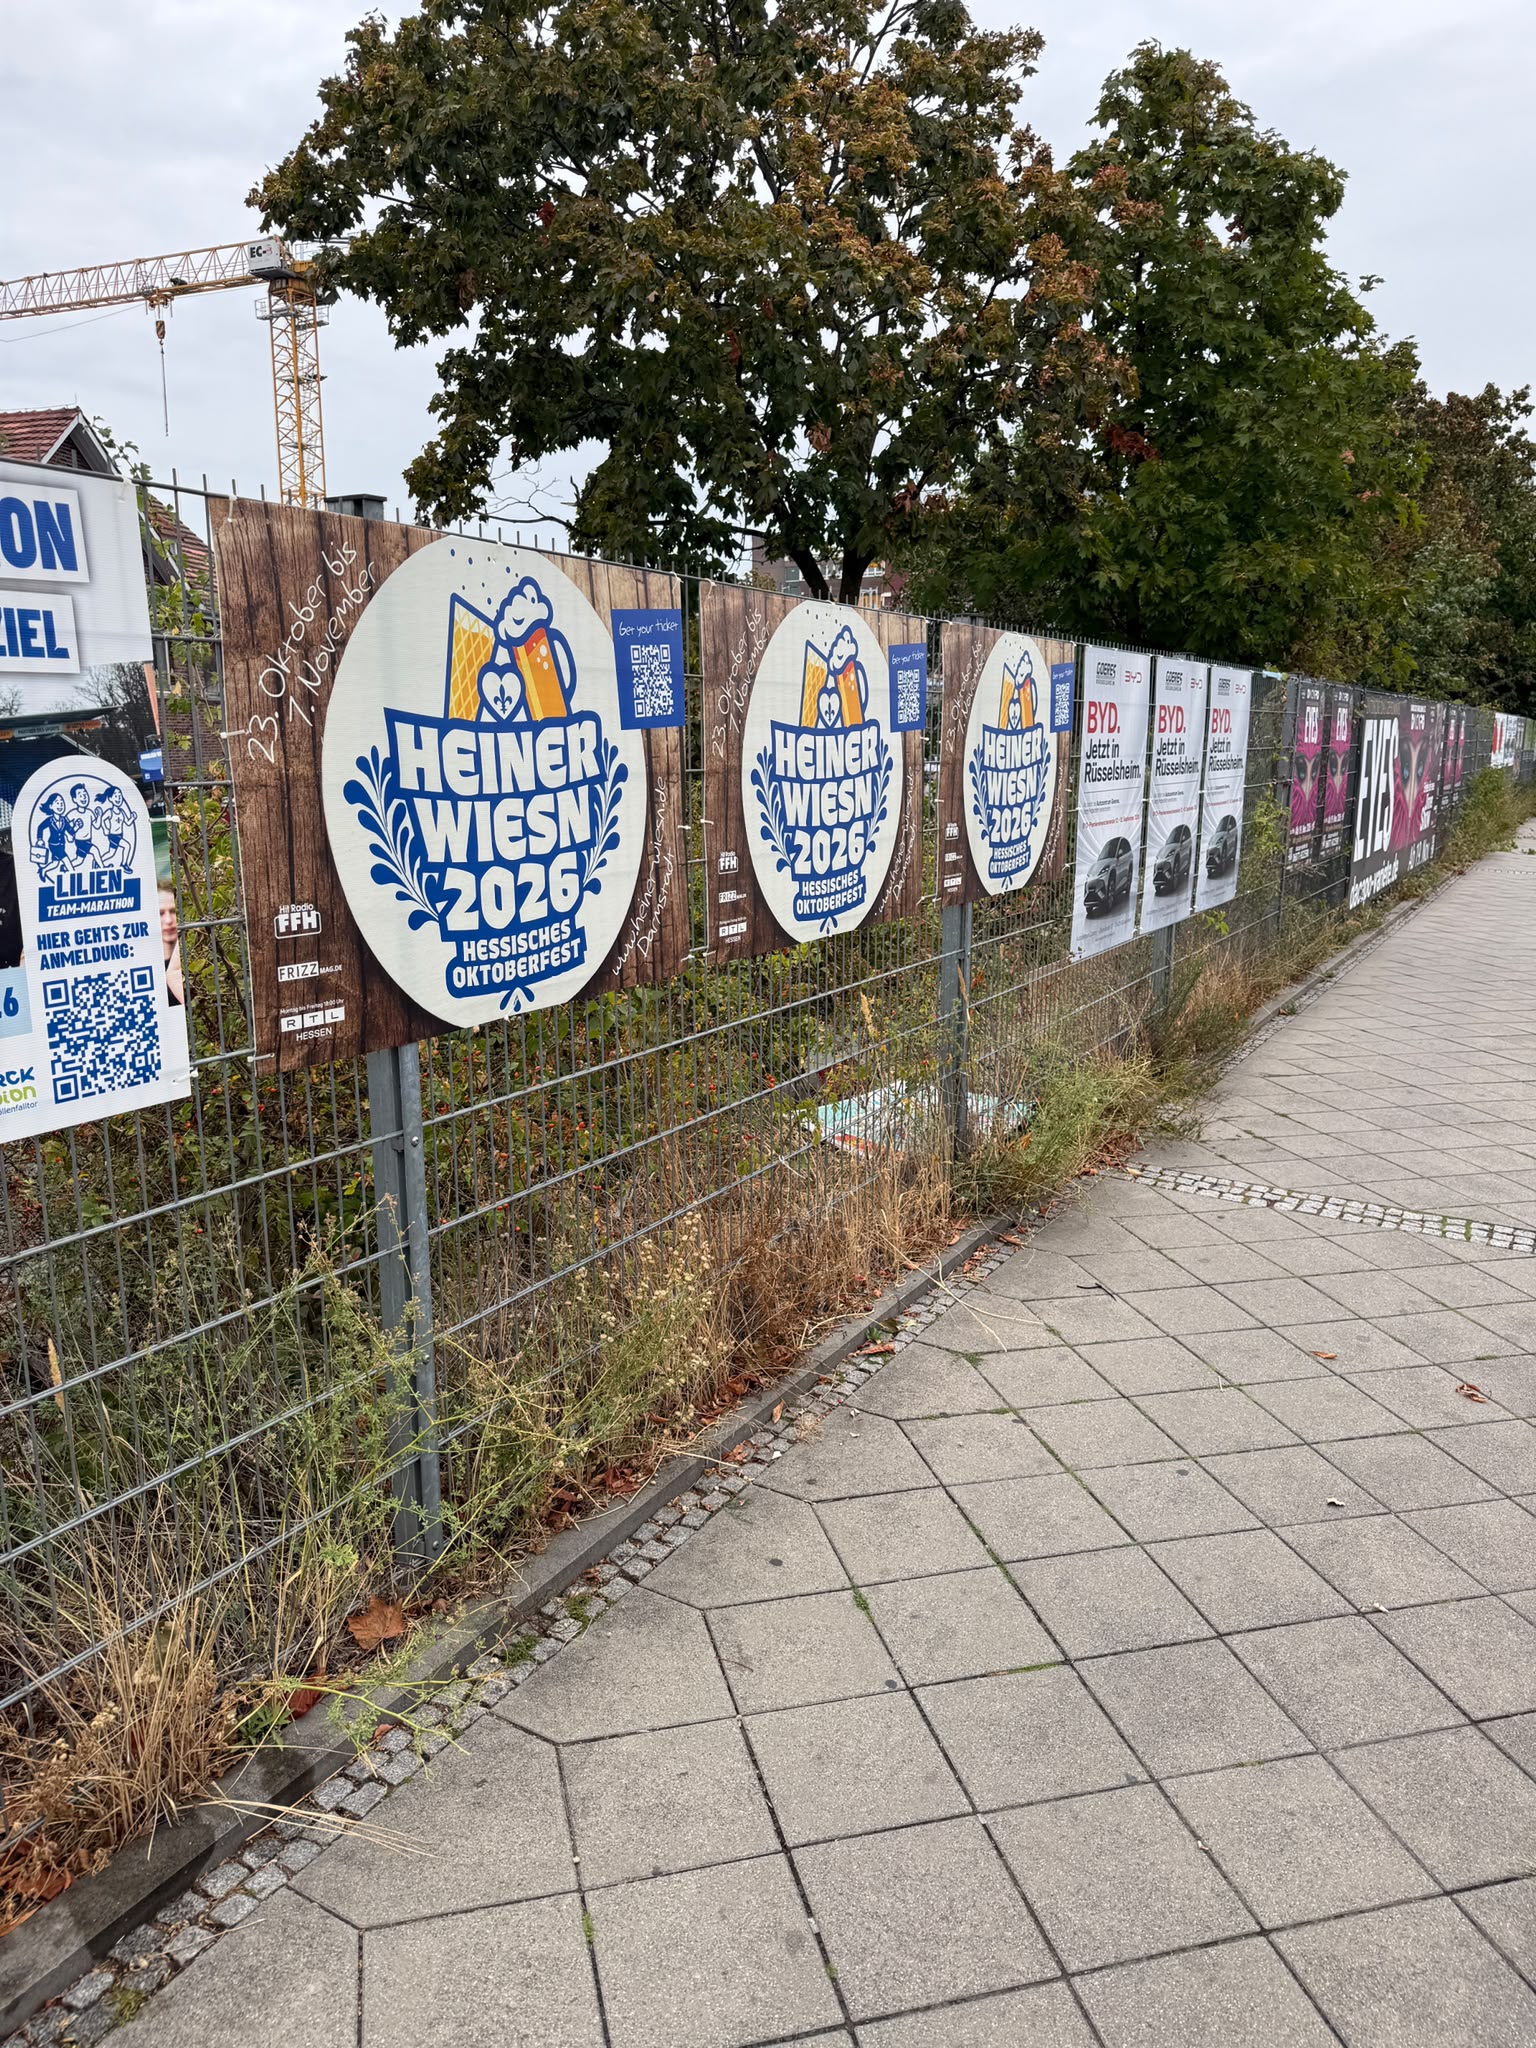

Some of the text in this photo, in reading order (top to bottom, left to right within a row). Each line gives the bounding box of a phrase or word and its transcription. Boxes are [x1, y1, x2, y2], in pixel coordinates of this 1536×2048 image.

[297, 561, 376, 696] November
[636, 624, 654, 637] your
[247, 541, 357, 764] 23. Oktober bis
[734, 620, 771, 714] November
[712, 608, 762, 758] 23. Oktober bis
[1124, 670, 1143, 684] BYD
[1087, 701, 1121, 734] BYD.
[1158, 704, 1186, 734] BYD.
[1211, 708, 1232, 734] BYD.
[1304, 706, 1319, 744] EYES
[1336, 707, 1348, 742] EYES
[394, 720, 601, 796] HEINER
[774, 726, 878, 780] HEINER
[984, 727, 1042, 771] HEINER
[1086, 738, 1119, 759] Jetzt in
[1157, 737, 1185, 756] Jetzt in
[1209, 737, 1231, 754] Jetzt in
[1084, 759, 1141, 783] Rüsselsheim.
[1155, 757, 1200, 777] Rüsselsheim.
[782, 772, 872, 827] WIESN
[987, 766, 1038, 806] WIESN
[1353, 717, 1399, 863] EYES
[413, 785, 592, 863] WIESN
[991, 801, 1032, 844] 2026
[720, 857, 737, 871] FFH
[793, 822, 865, 875] 2026
[990, 852, 1030, 874] OKTOBERFEST
[994, 839, 1027, 860] HESSISCHES
[56, 869, 122, 898] LILIEN
[443, 851, 580, 931] 2026
[612, 776, 668, 976] www.heinerwiesn.de
[802, 869, 859, 896] HESSISCHES
[47, 896, 134, 917] TEAM-MARATHON
[290, 903, 314, 912] Radio
[636, 847, 675, 958] Darmstadt
[796, 884, 864, 915] OKTOBERFEST
[37, 921, 149, 951] HIER GEHTS ZUR
[278, 910, 318, 933] FFH
[462, 918, 572, 962] HESSISCHES
[40, 943, 134, 971] ANMELDUNG:
[279, 963, 318, 980] FRIZZ
[452, 938, 582, 989] OKTOBERFEST
[0, 986, 19, 1019] 6
[296, 1027, 333, 1041] HESSEN
